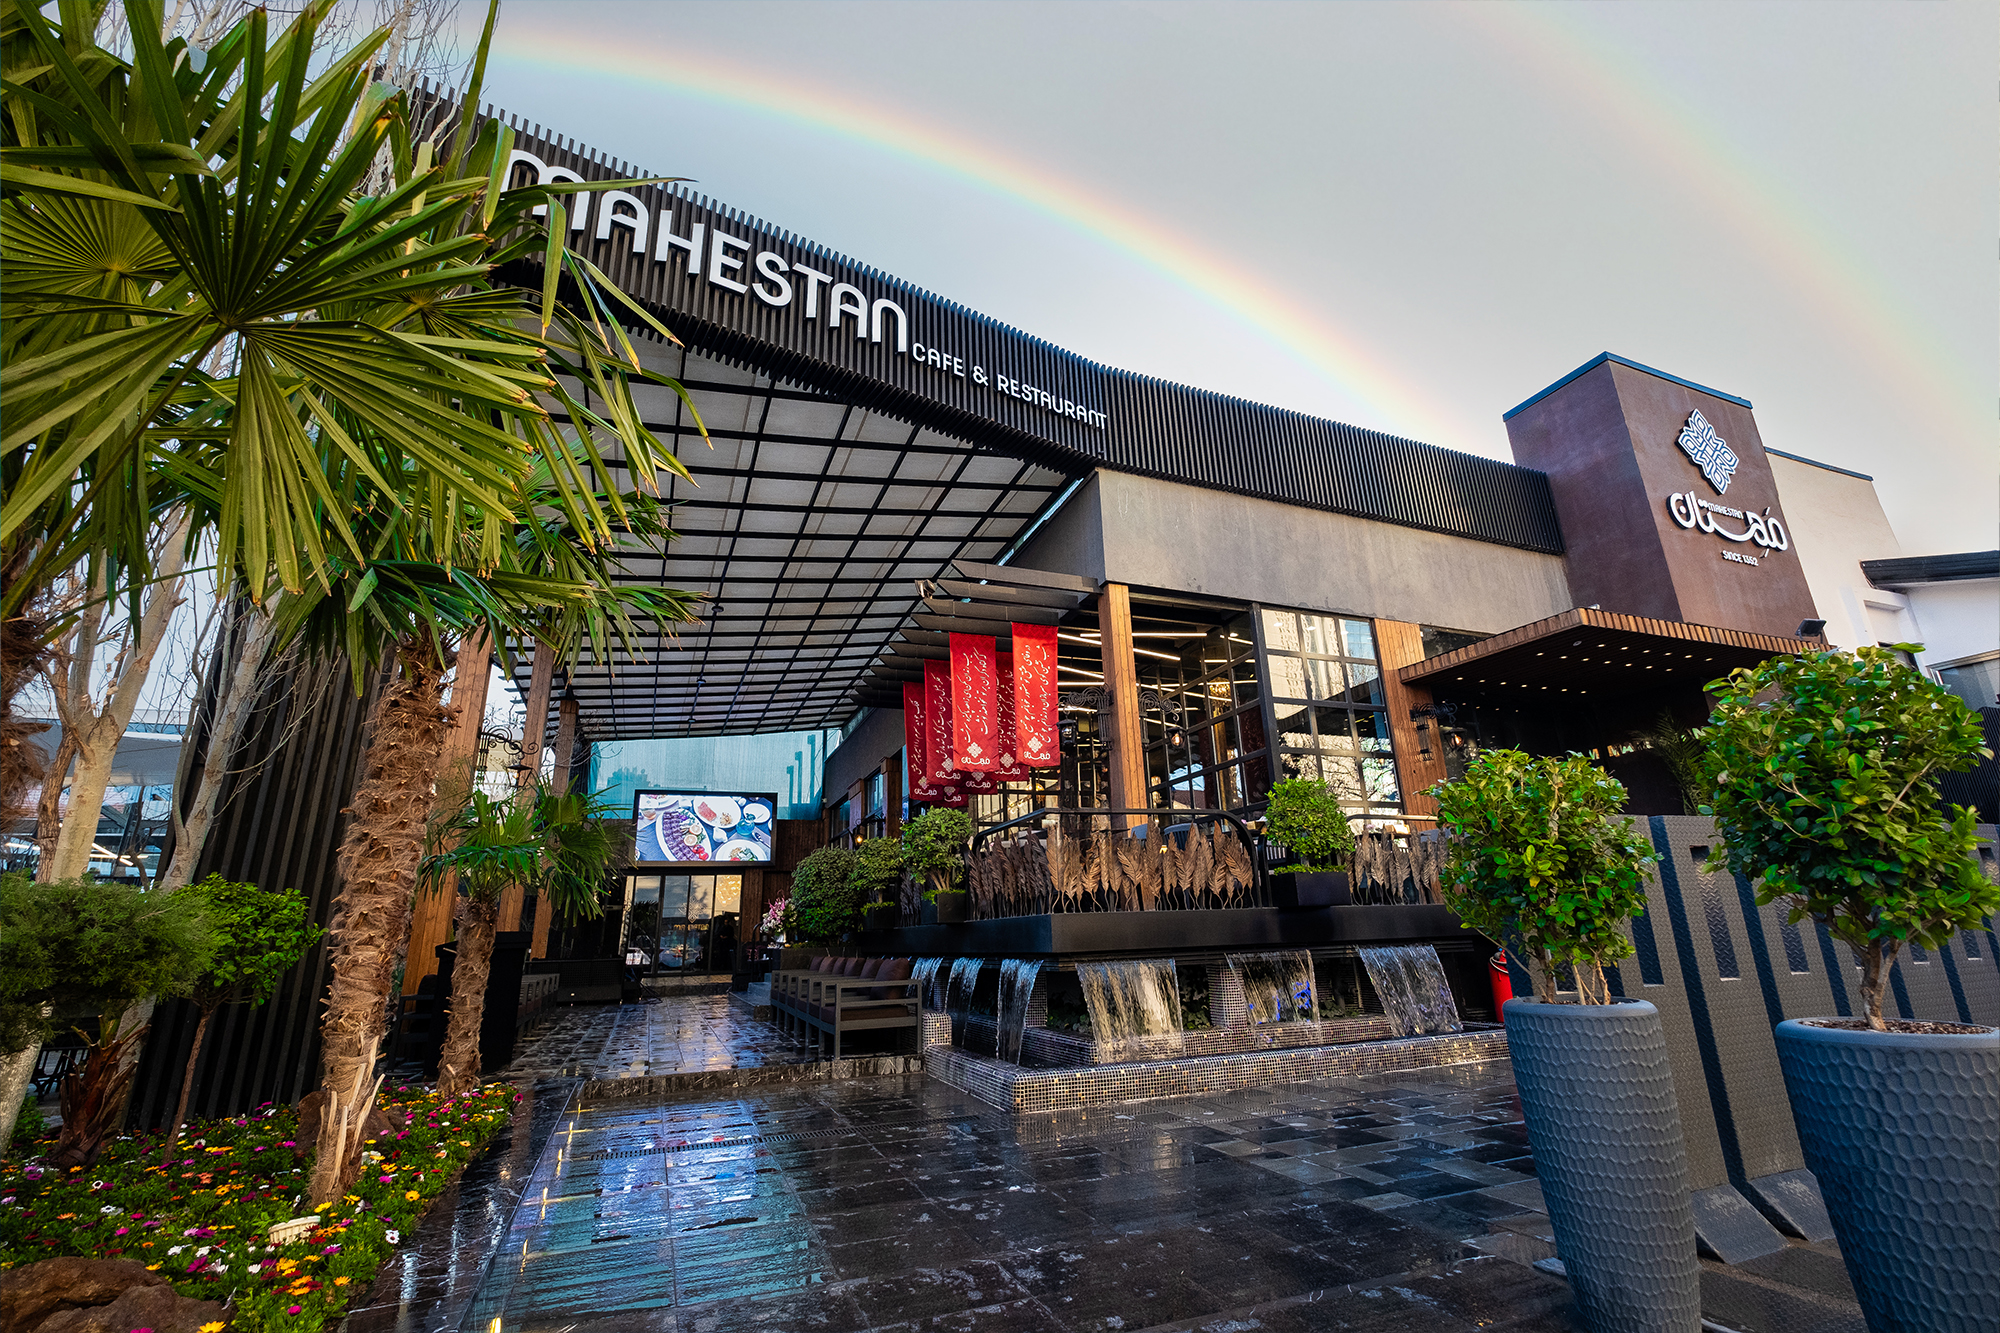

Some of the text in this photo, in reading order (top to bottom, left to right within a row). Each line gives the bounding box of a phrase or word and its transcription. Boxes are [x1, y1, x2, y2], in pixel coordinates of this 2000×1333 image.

[499, 149, 909, 352] MAHESTAN
[912, 343, 1107, 430] CAFE & RESTAURANT
[1722, 550, 1743, 563] SINCE
